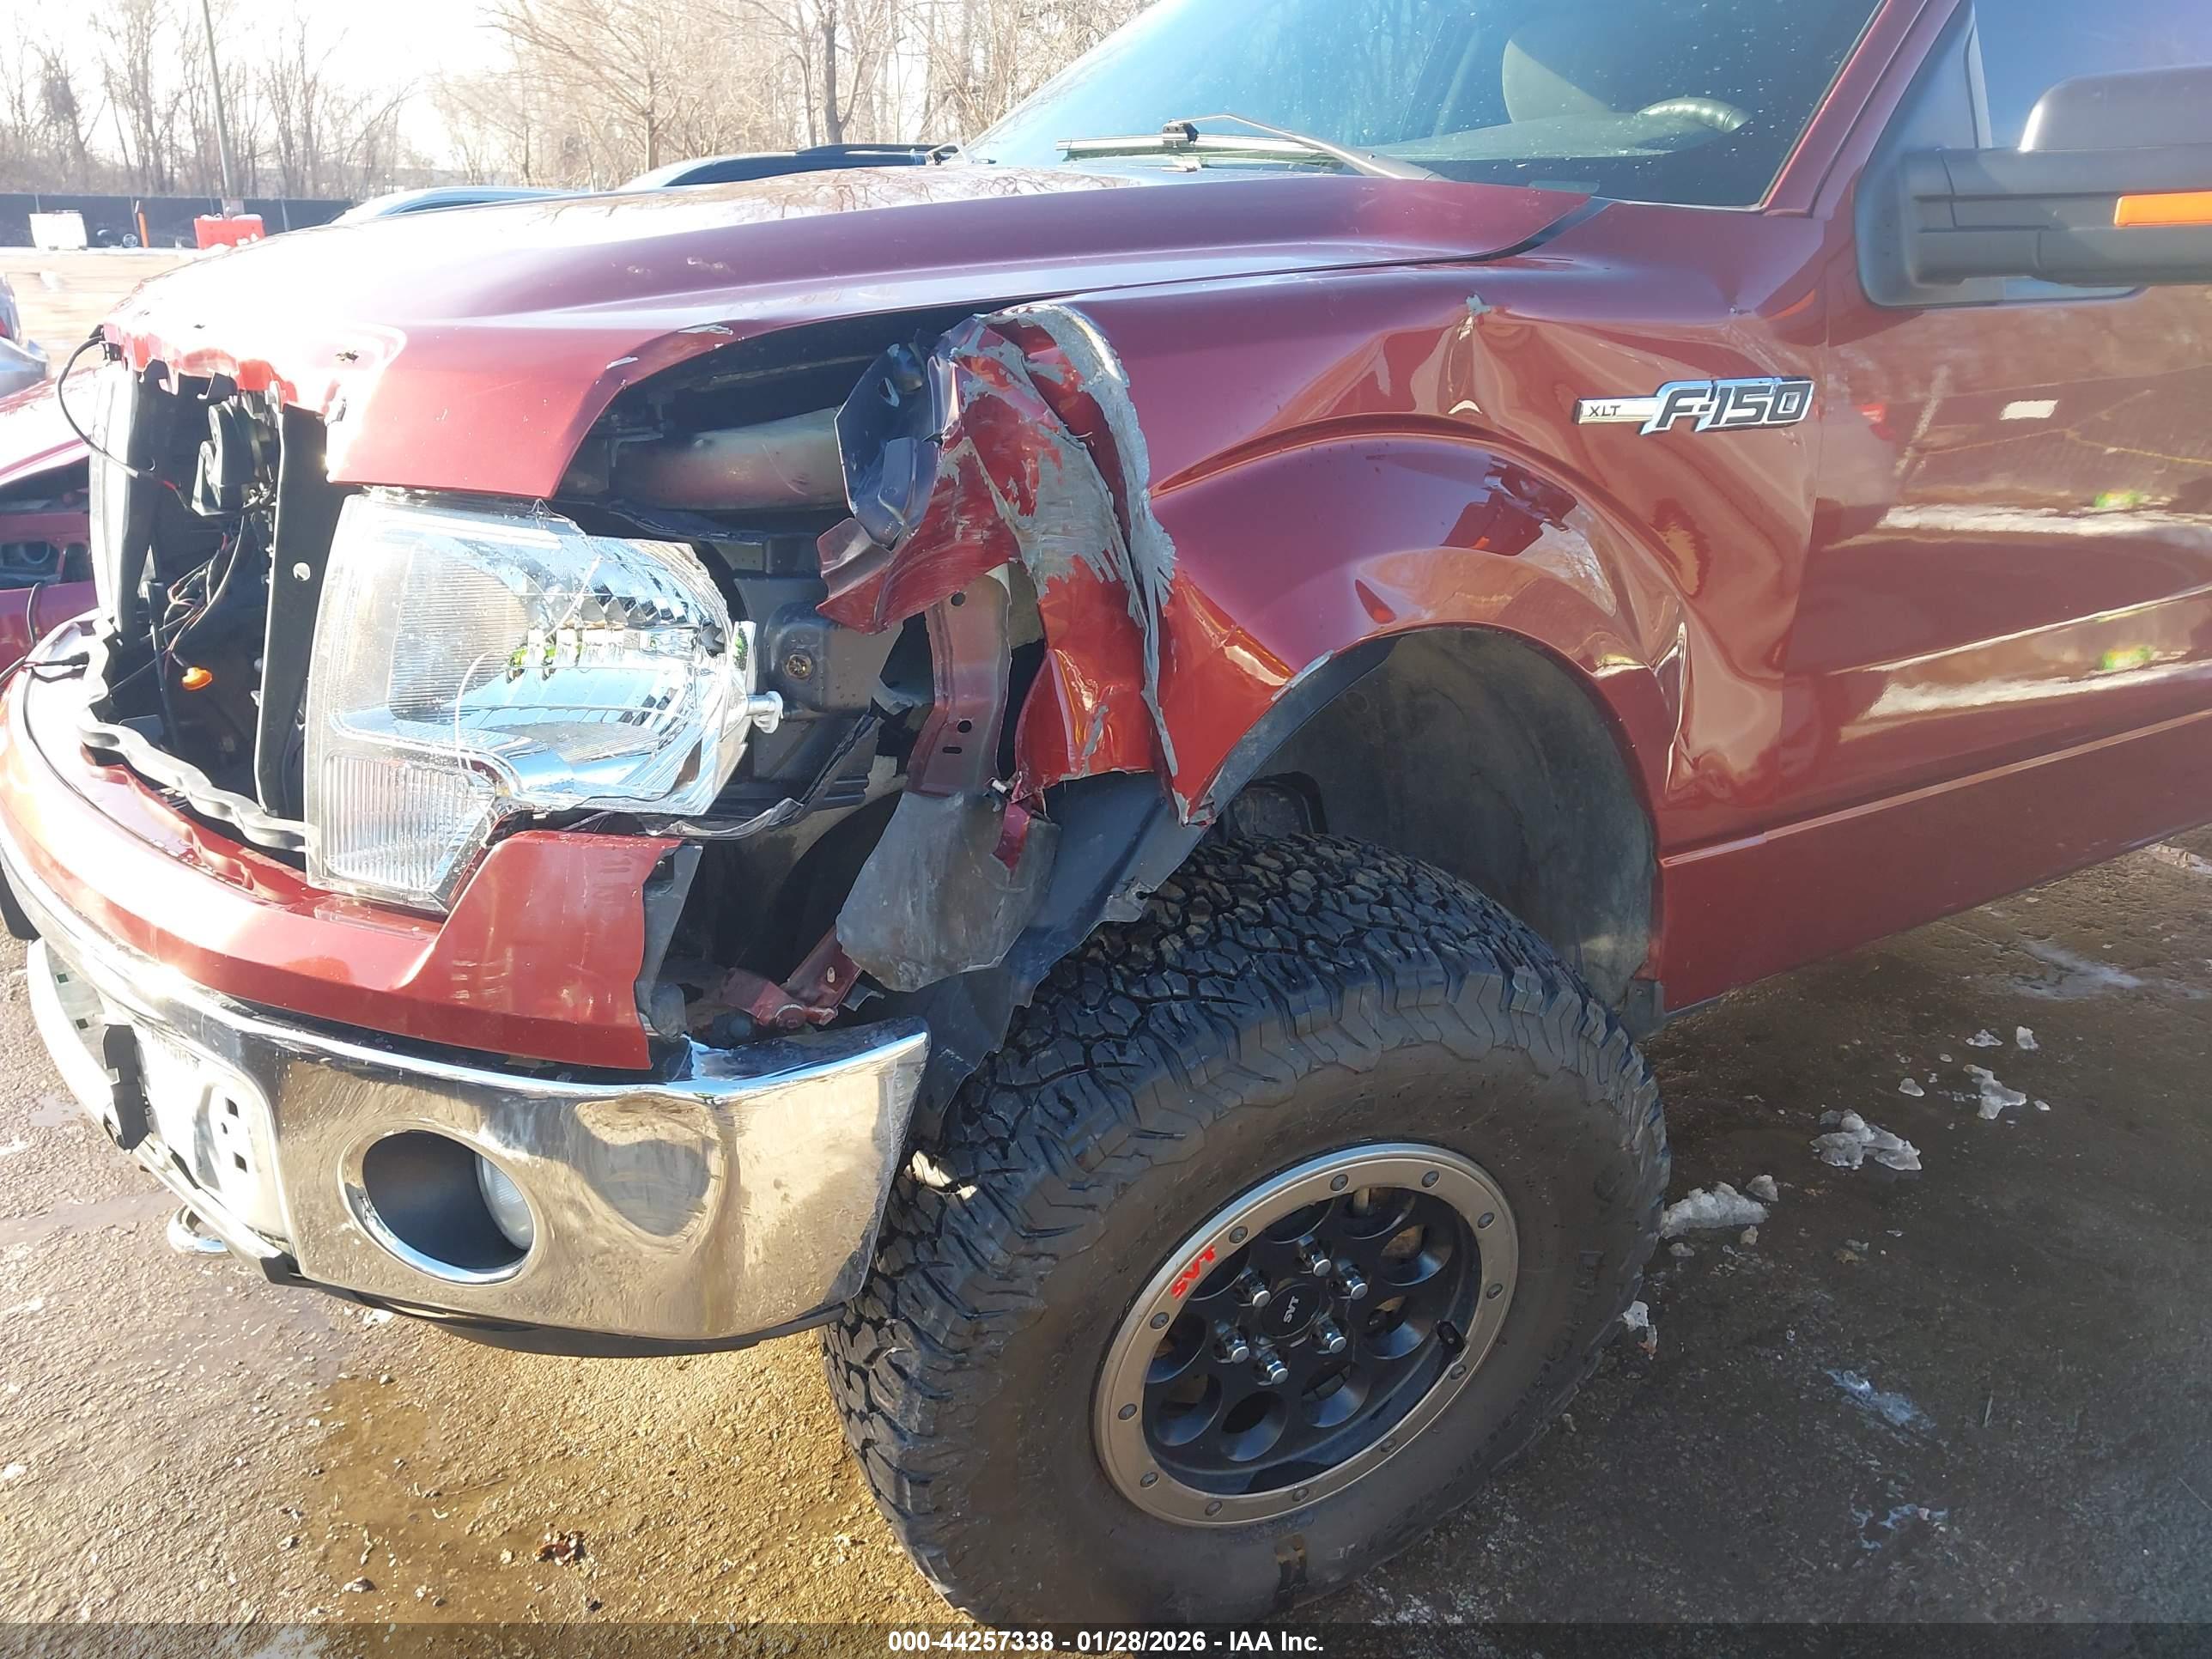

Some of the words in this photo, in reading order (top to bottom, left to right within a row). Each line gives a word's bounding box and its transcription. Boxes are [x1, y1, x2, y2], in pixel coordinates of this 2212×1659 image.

[1589, 404, 1621, 417] XLT
[1642, 379, 1814, 434] F-150
[1171, 1245, 1217, 1299] SVT
[1283, 1296, 1299, 1323] SVT
